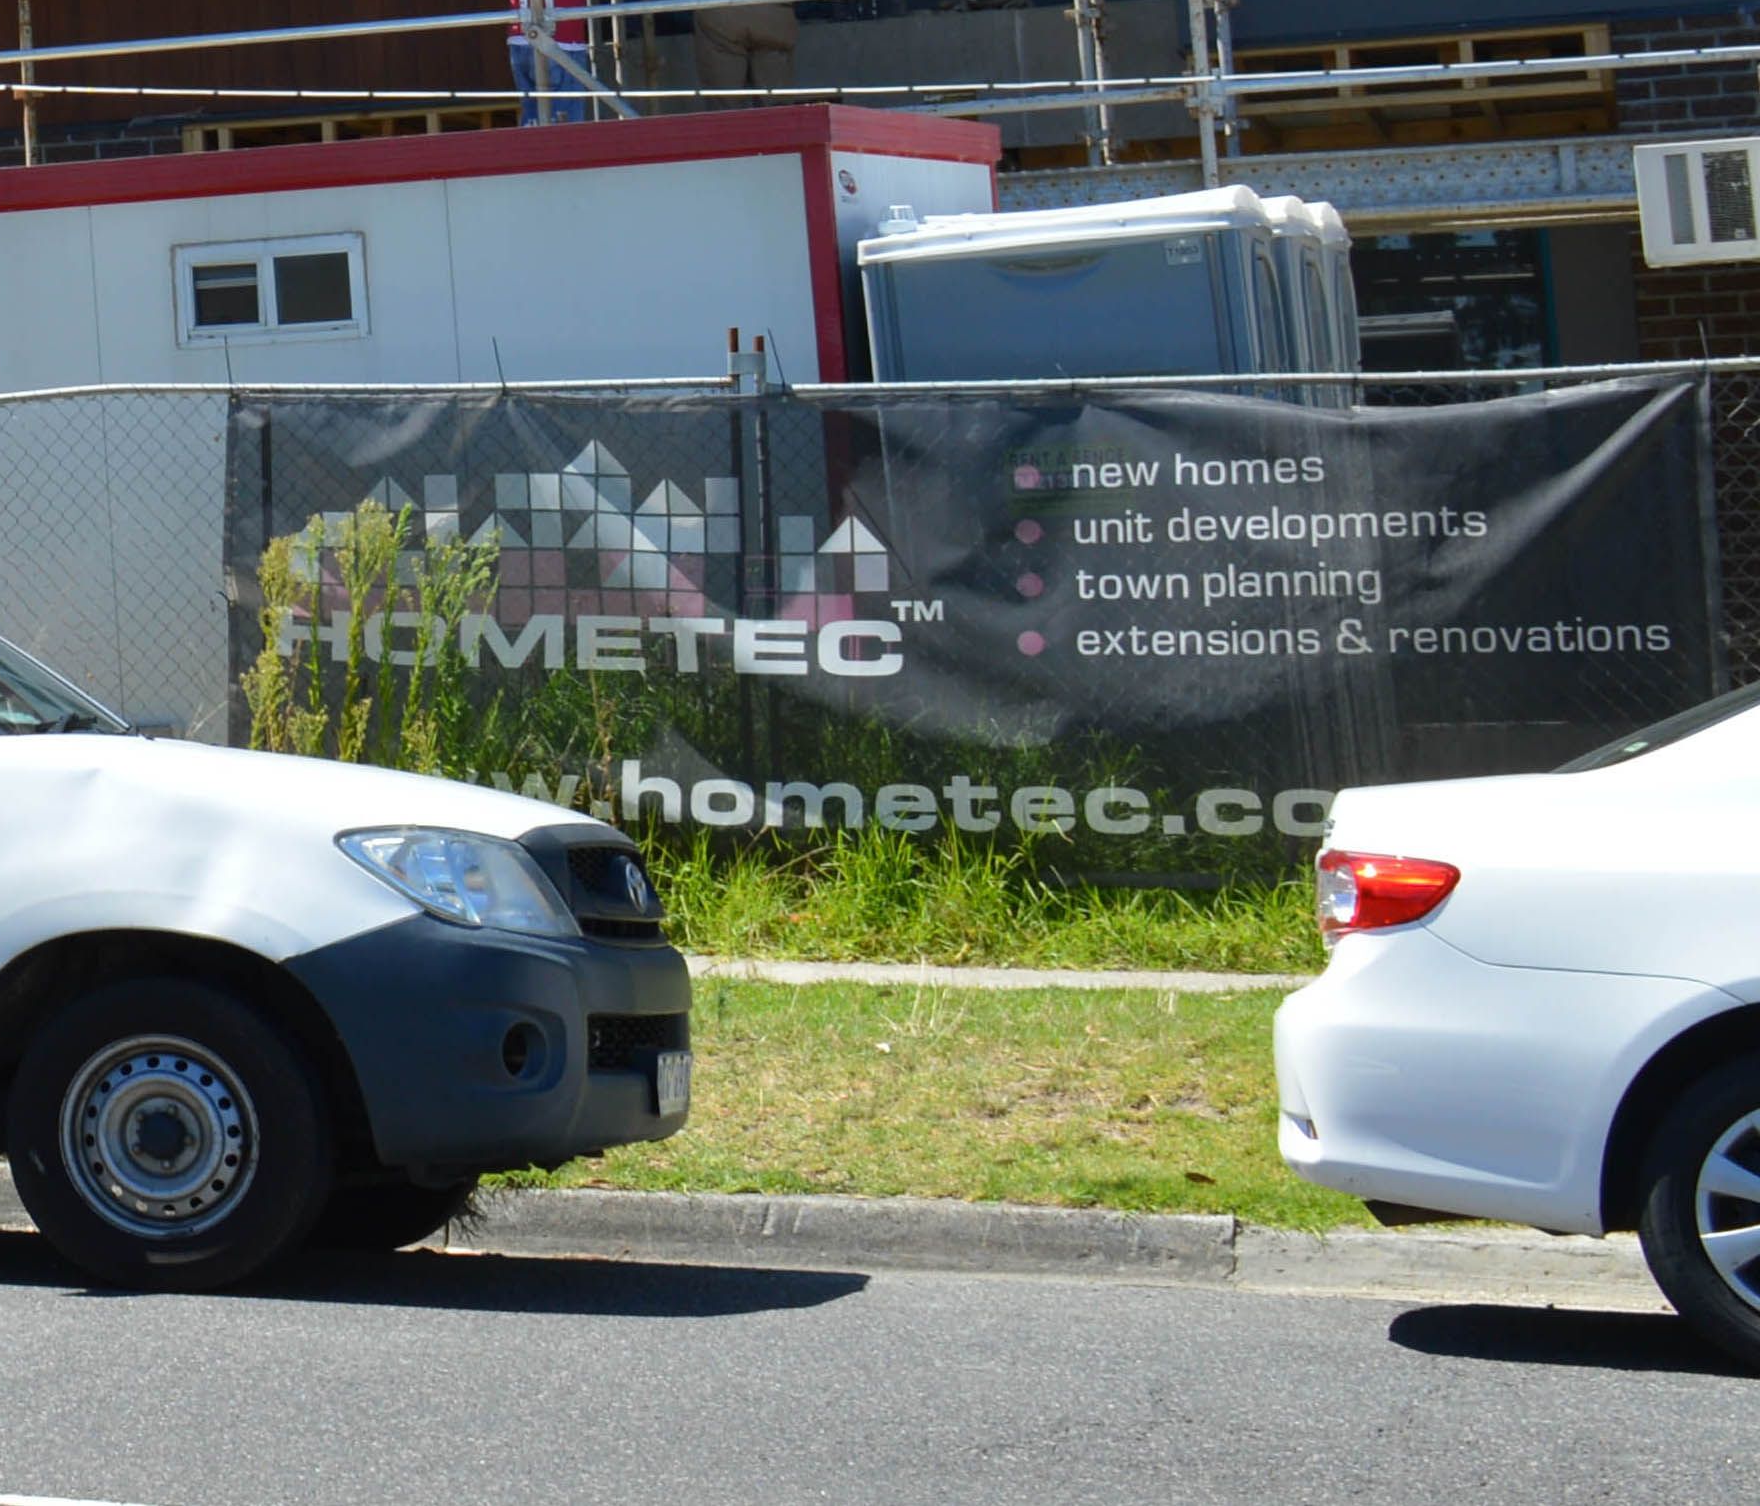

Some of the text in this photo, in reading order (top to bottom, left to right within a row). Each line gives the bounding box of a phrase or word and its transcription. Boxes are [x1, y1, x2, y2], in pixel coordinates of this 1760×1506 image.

[1072, 461, 1159, 489] new
[1175, 453, 1325, 486] homes
[1074, 506, 1488, 548] unit developments
[1076, 562, 1382, 608] town planning
[280, 607, 904, 676] HOMETEC
[1077, 615, 1672, 656] extensions & renovations
[465, 759, 1333, 836] w.hometec.co
